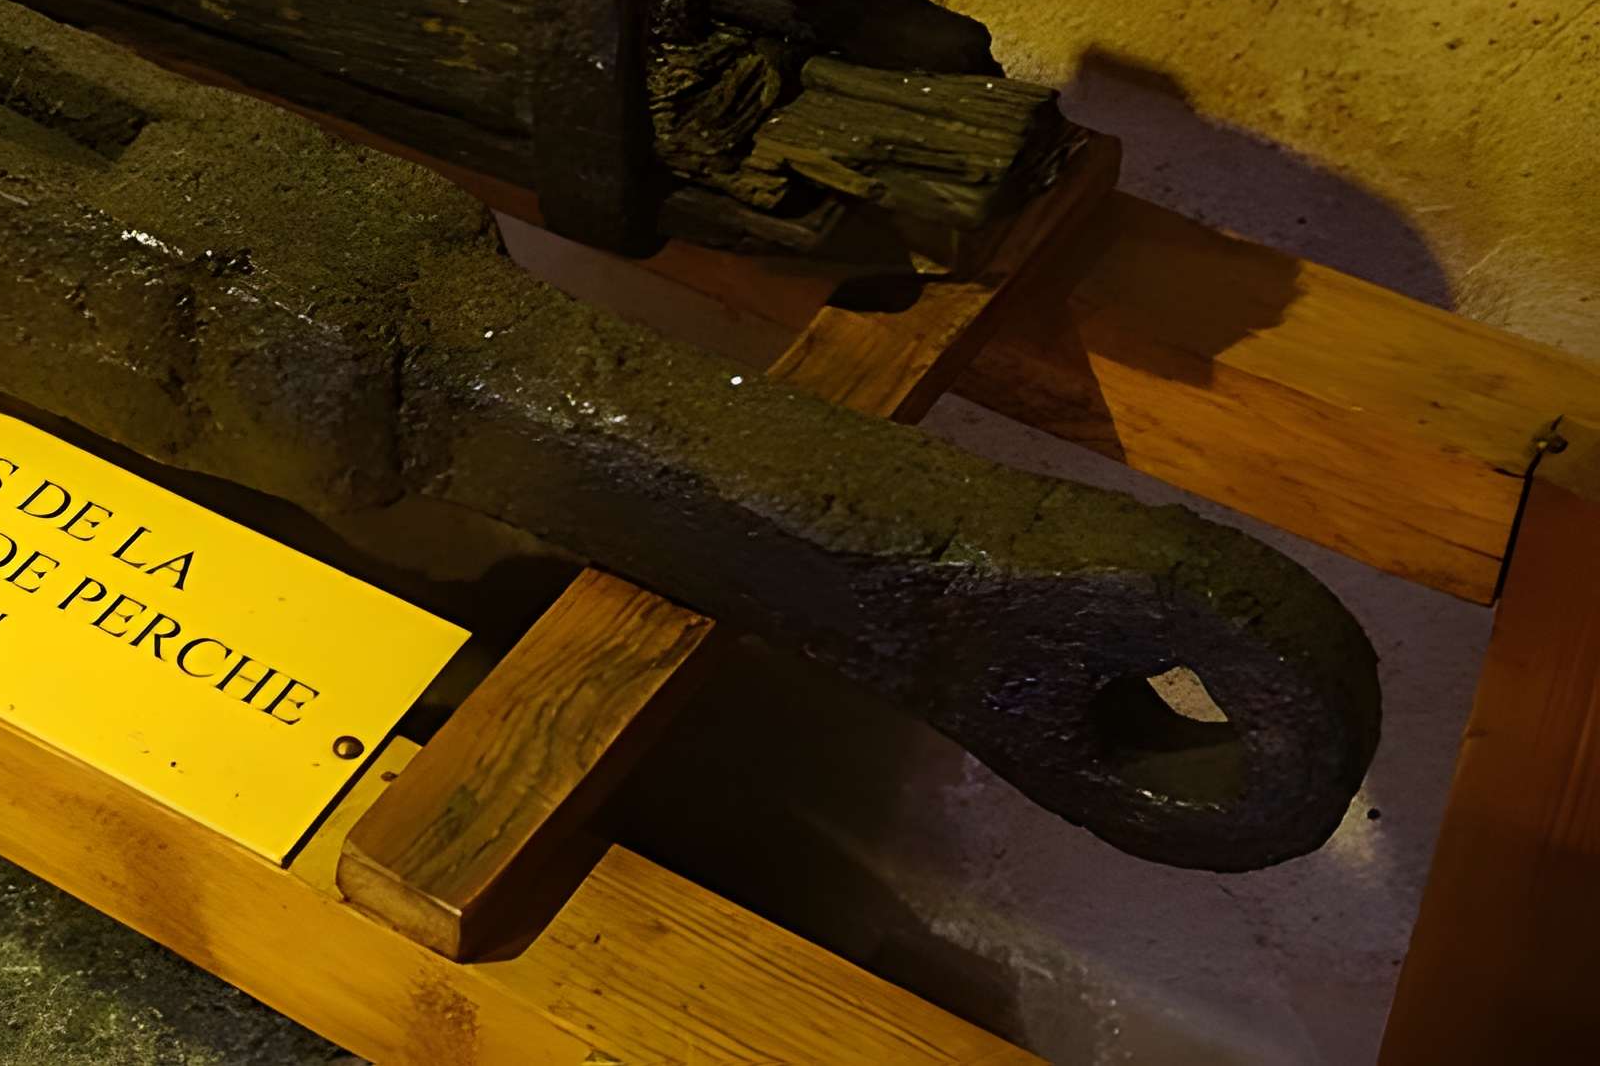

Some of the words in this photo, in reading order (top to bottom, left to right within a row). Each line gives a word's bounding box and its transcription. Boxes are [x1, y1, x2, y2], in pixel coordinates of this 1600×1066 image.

[16, 479, 113, 541] DE
[111, 527, 195, 592] LA
[58, 578, 320, 726] PERCHE
